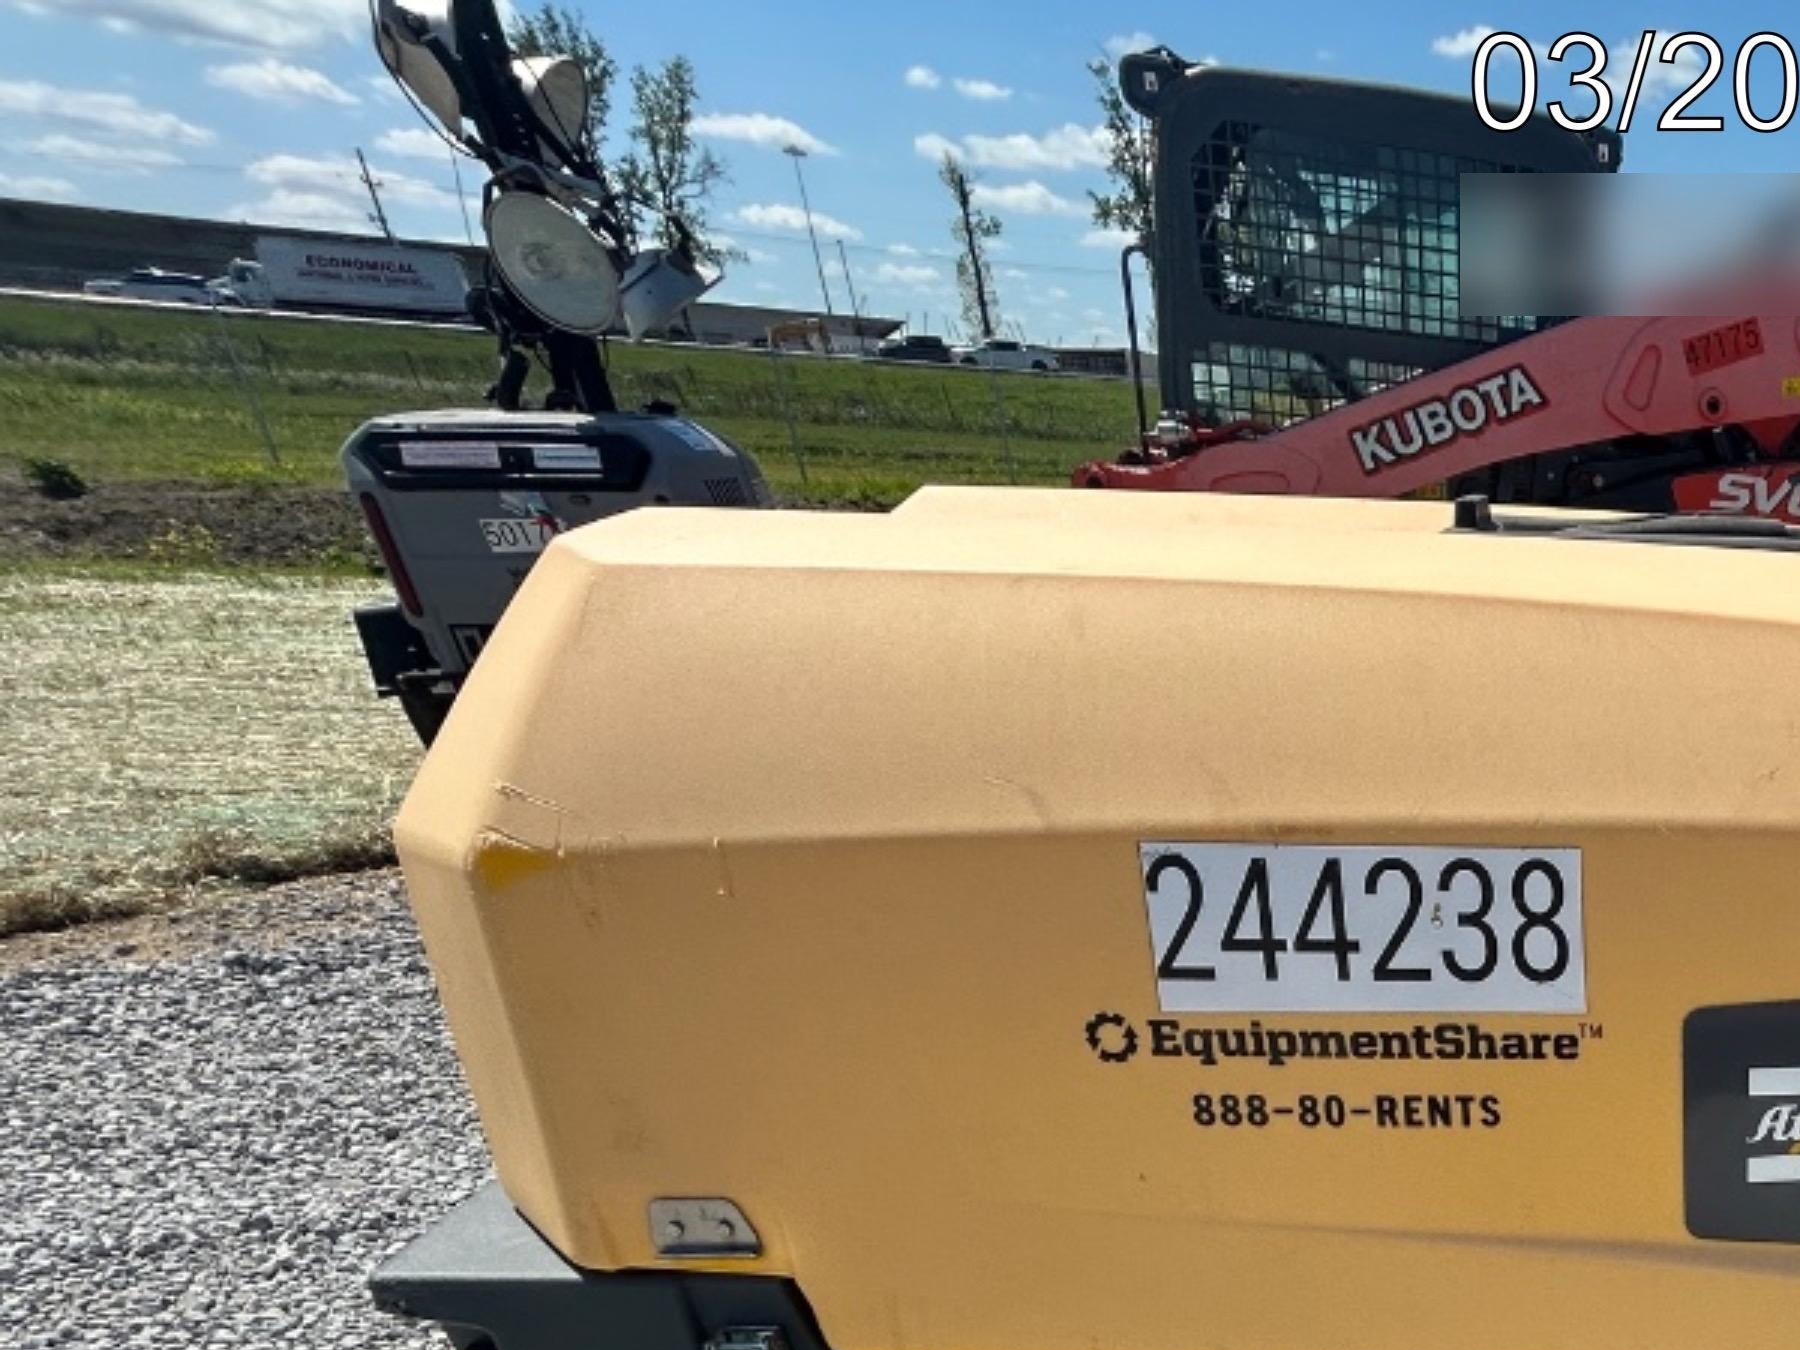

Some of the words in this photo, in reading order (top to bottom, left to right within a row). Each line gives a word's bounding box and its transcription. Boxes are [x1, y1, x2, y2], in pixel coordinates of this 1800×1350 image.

[305, 254, 417, 274] ECONOMICAL
[1685, 320, 1760, 368] 47175
[1351, 367, 1544, 470] KUBOTA
[1146, 853, 1571, 983] 244238
[1192, 1093, 1502, 1128] 888-80-RENTS
